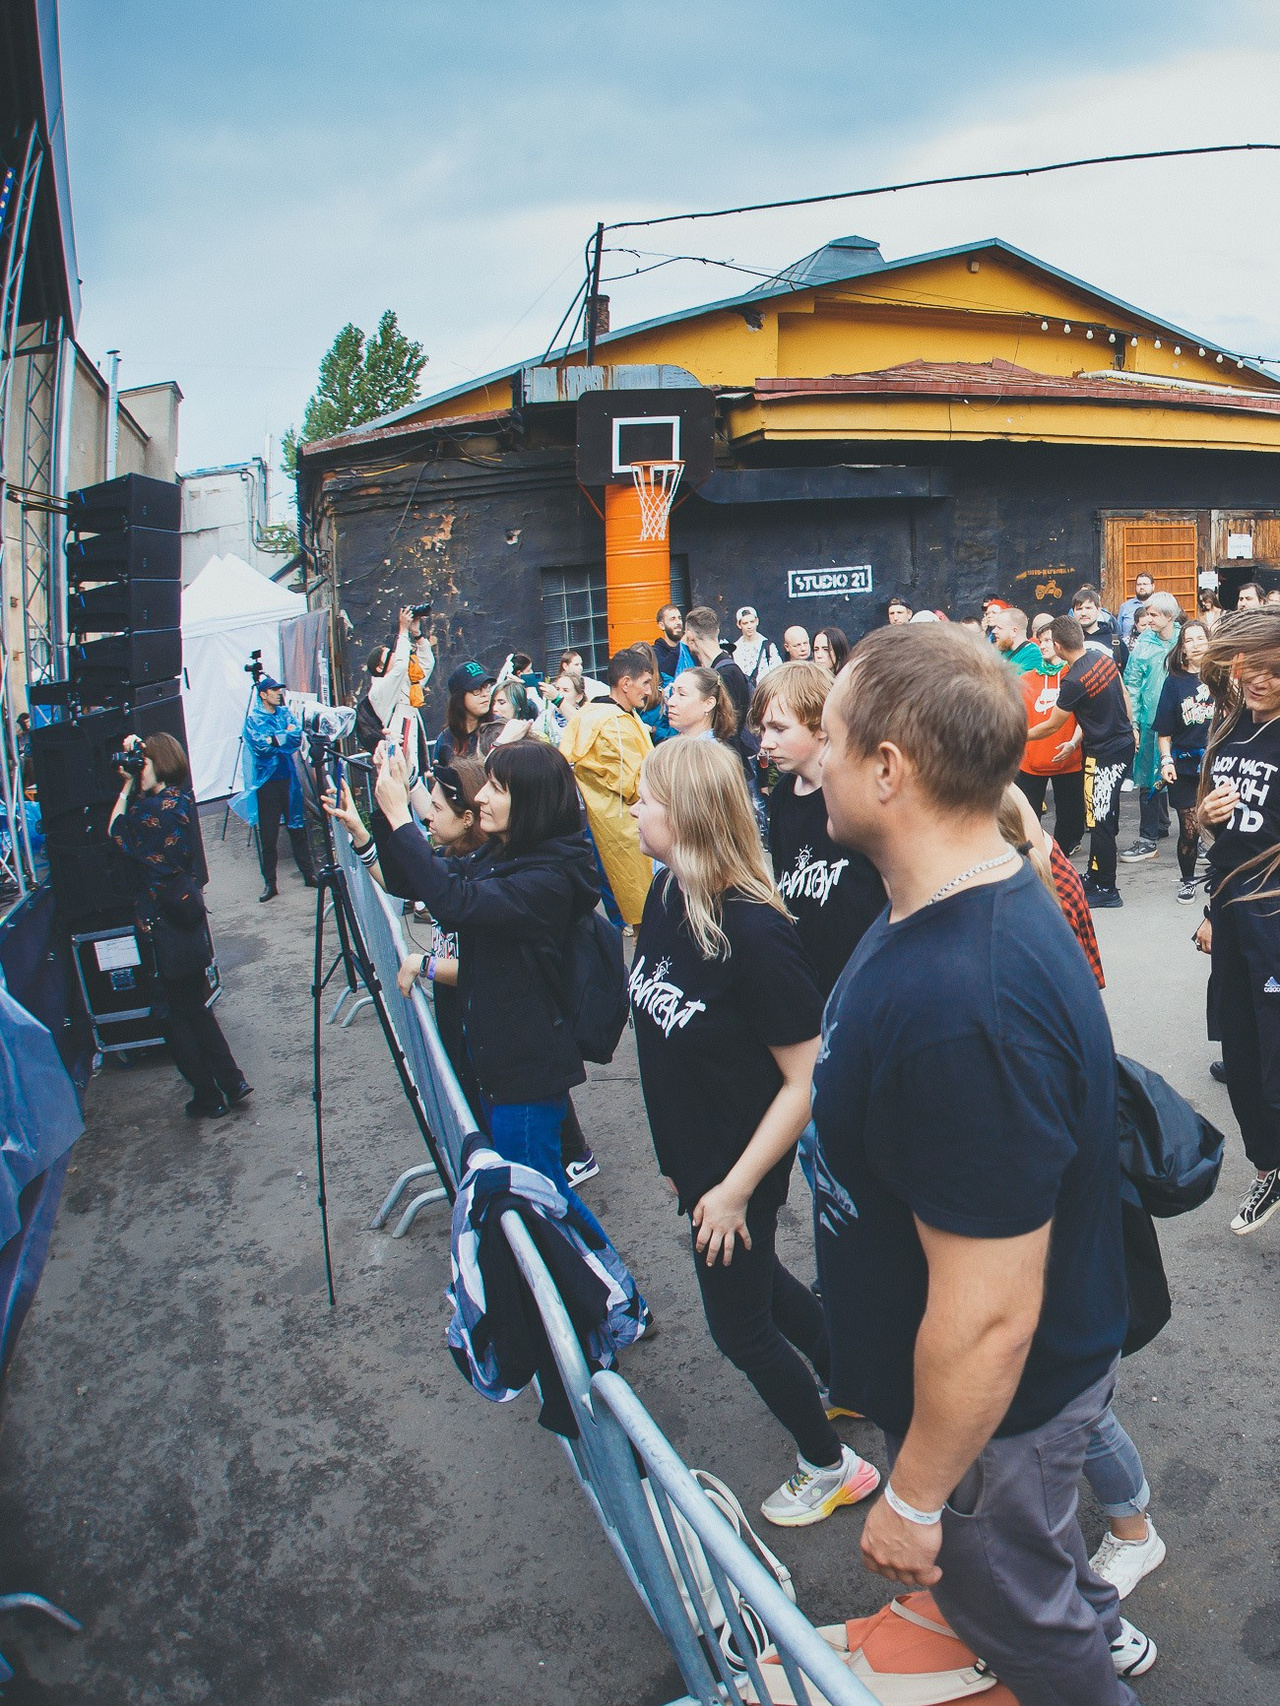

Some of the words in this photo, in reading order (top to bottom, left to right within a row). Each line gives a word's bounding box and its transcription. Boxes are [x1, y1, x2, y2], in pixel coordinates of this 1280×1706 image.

[795, 573, 848, 591] STUDIO
[851, 572, 866, 588] 21
[1239, 758, 1279, 781] МАСТ
